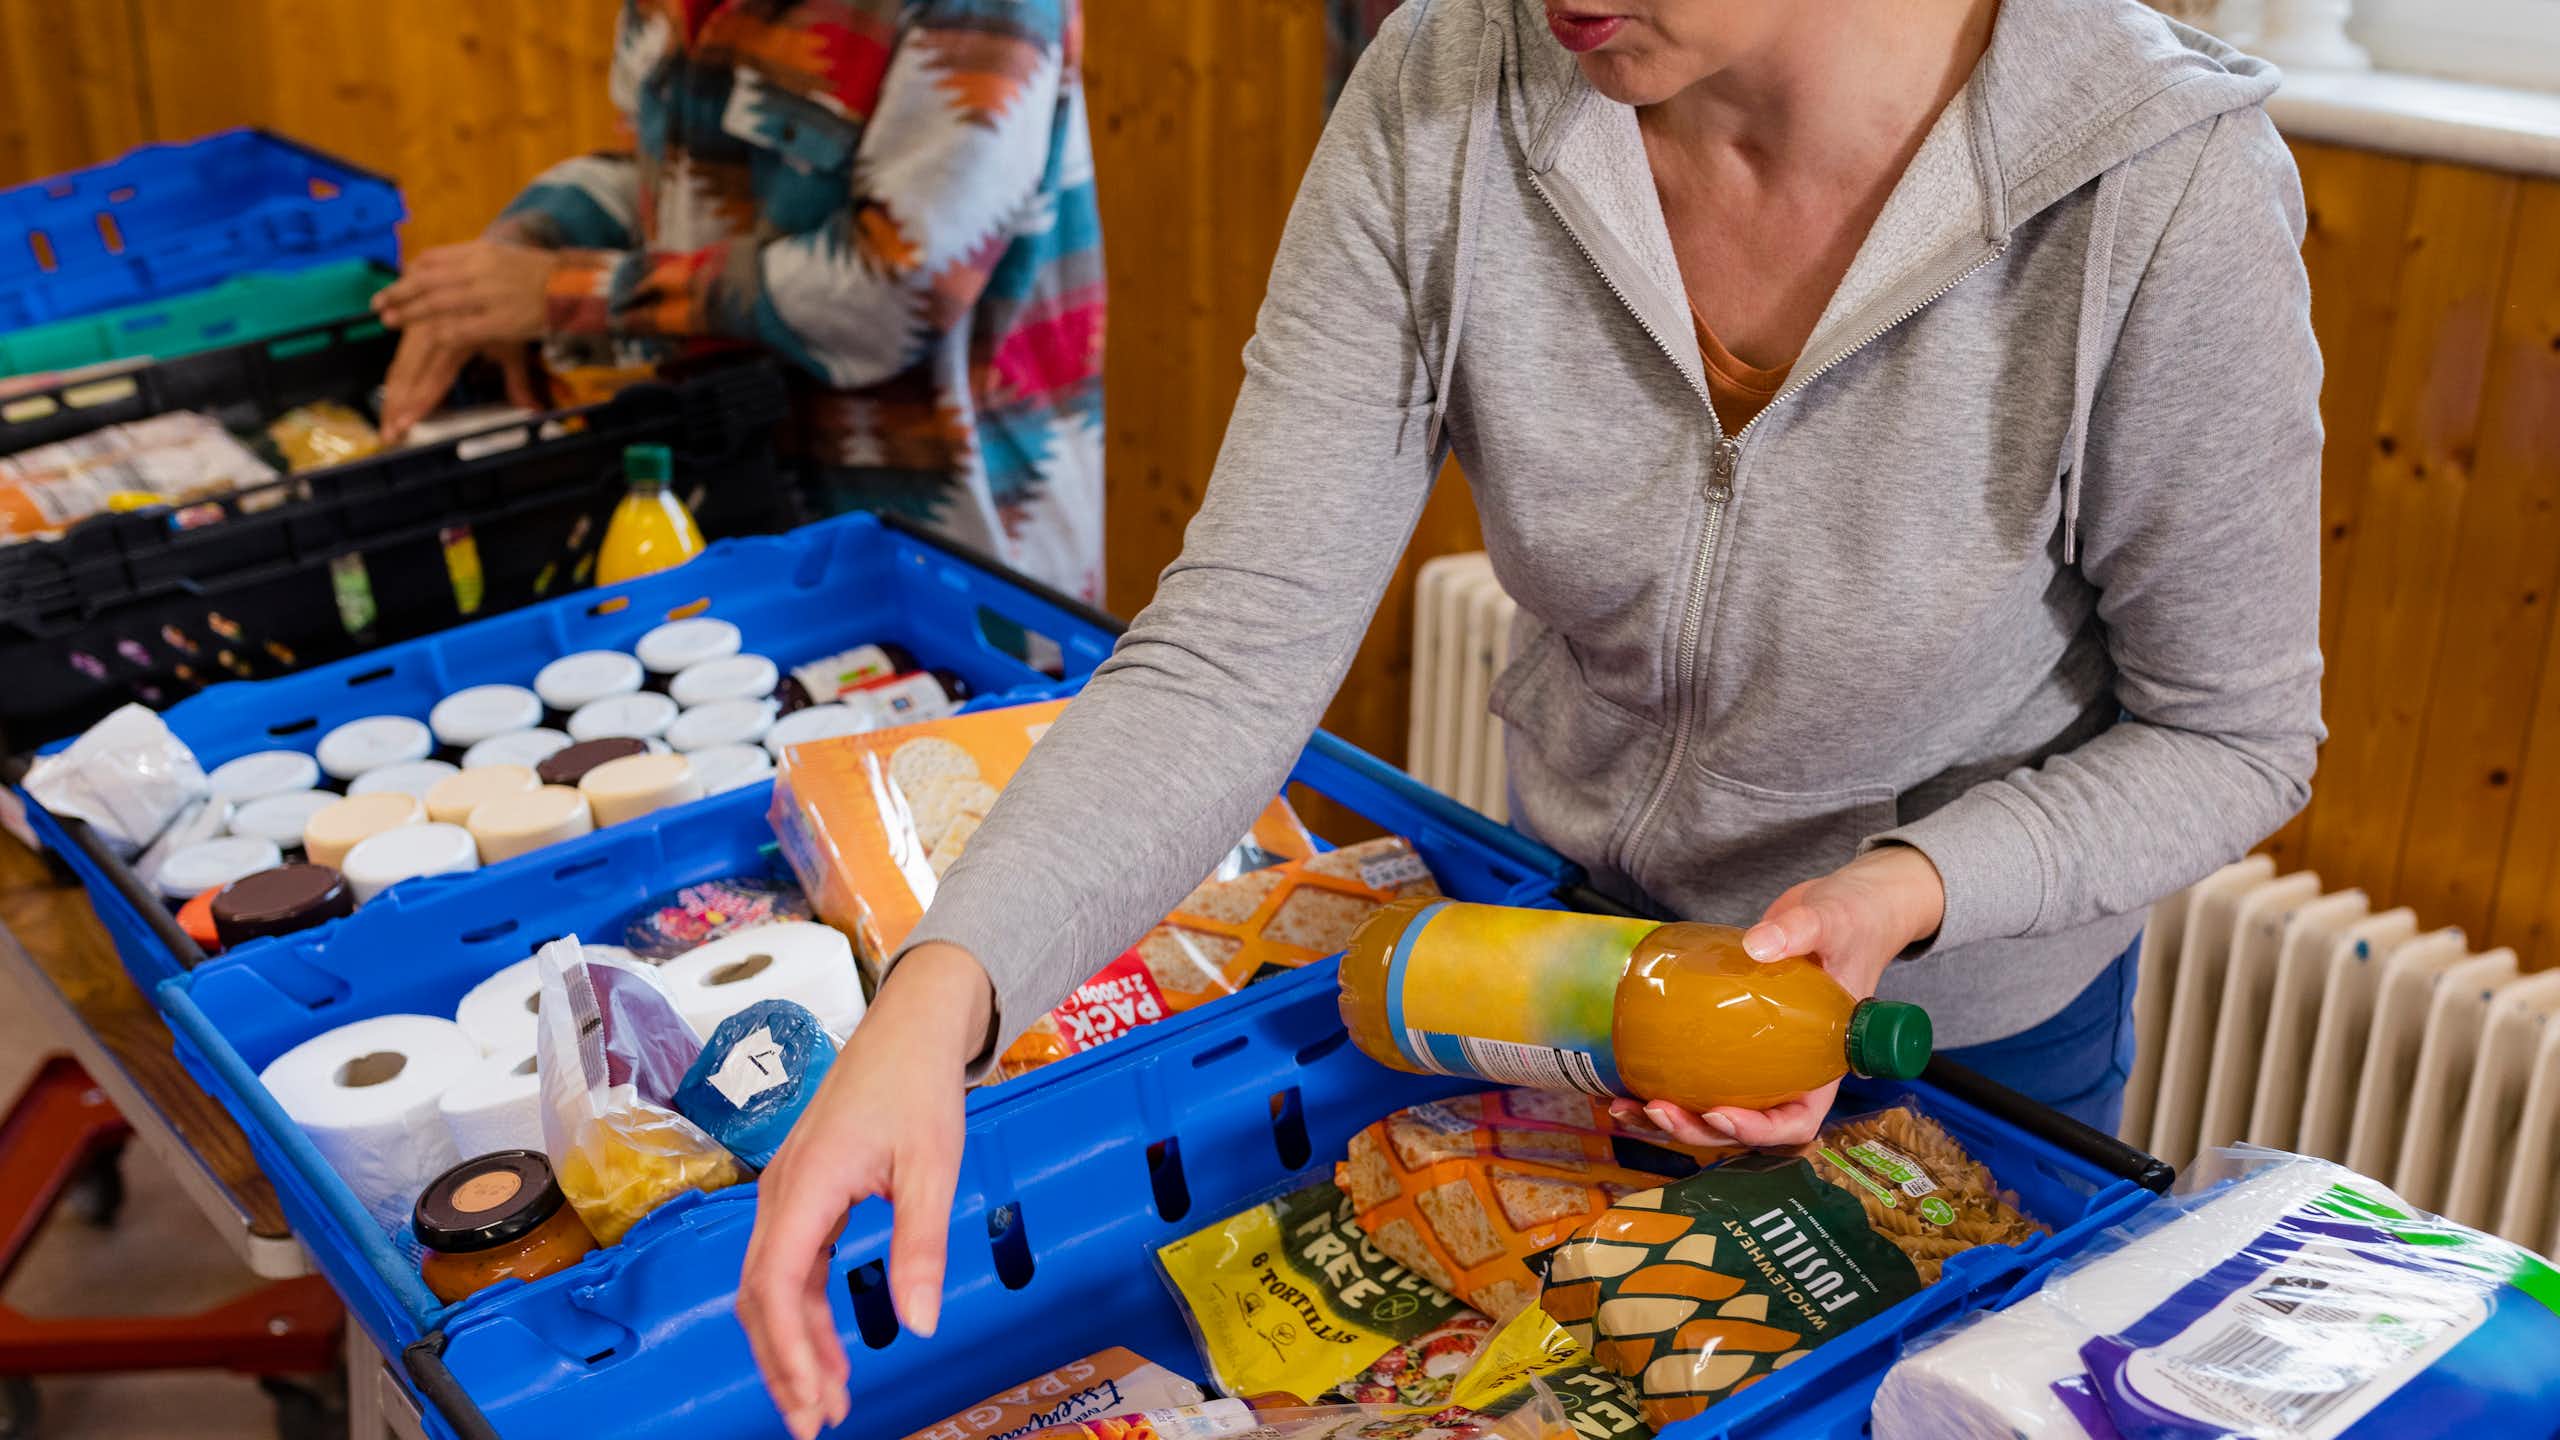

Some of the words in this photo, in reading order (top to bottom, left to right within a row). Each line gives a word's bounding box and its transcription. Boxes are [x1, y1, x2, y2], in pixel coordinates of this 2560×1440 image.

[1130, 973, 1148, 994] 2
[1062, 991, 1162, 1042] PACK
[1807, 1215, 1831, 1240] durum
[1827, 1239, 1848, 1259] 100%
[1295, 1210, 1387, 1309] FREE
[1722, 1219, 1829, 1331] WHOLEWHEAT
[1748, 1207, 1861, 1314] FUSILLI
[1845, 1257, 1861, 1274] with
[1259, 1267, 1359, 1344] TORTILLAS
